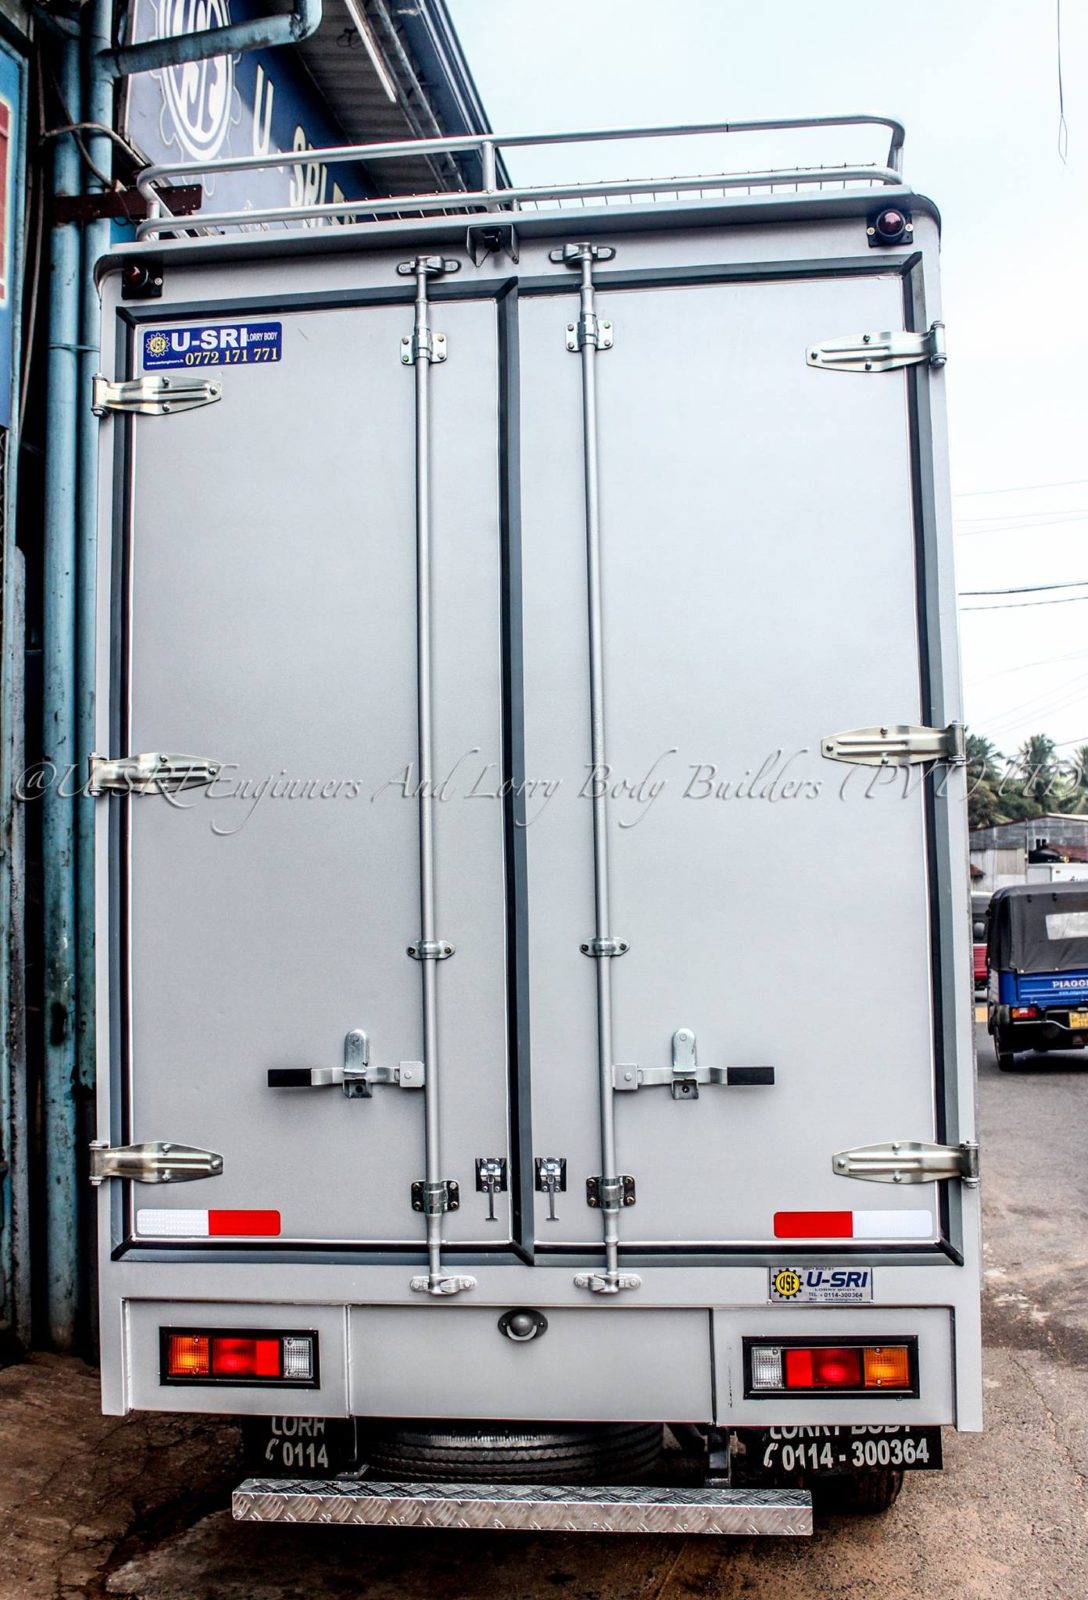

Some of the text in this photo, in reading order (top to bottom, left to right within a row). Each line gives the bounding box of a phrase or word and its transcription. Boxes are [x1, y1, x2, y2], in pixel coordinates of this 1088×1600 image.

[171, 328, 247, 352] U-SRI
[264, 331, 278, 340] BODY
[185, 351, 219, 365] 0772
[224, 349, 247, 363] 171
[254, 347, 278, 361] 771
[779, 1274, 795, 1292] USE
[806, 1271, 868, 1288] U-SRI
[283, 1441, 329, 1468] 0114
